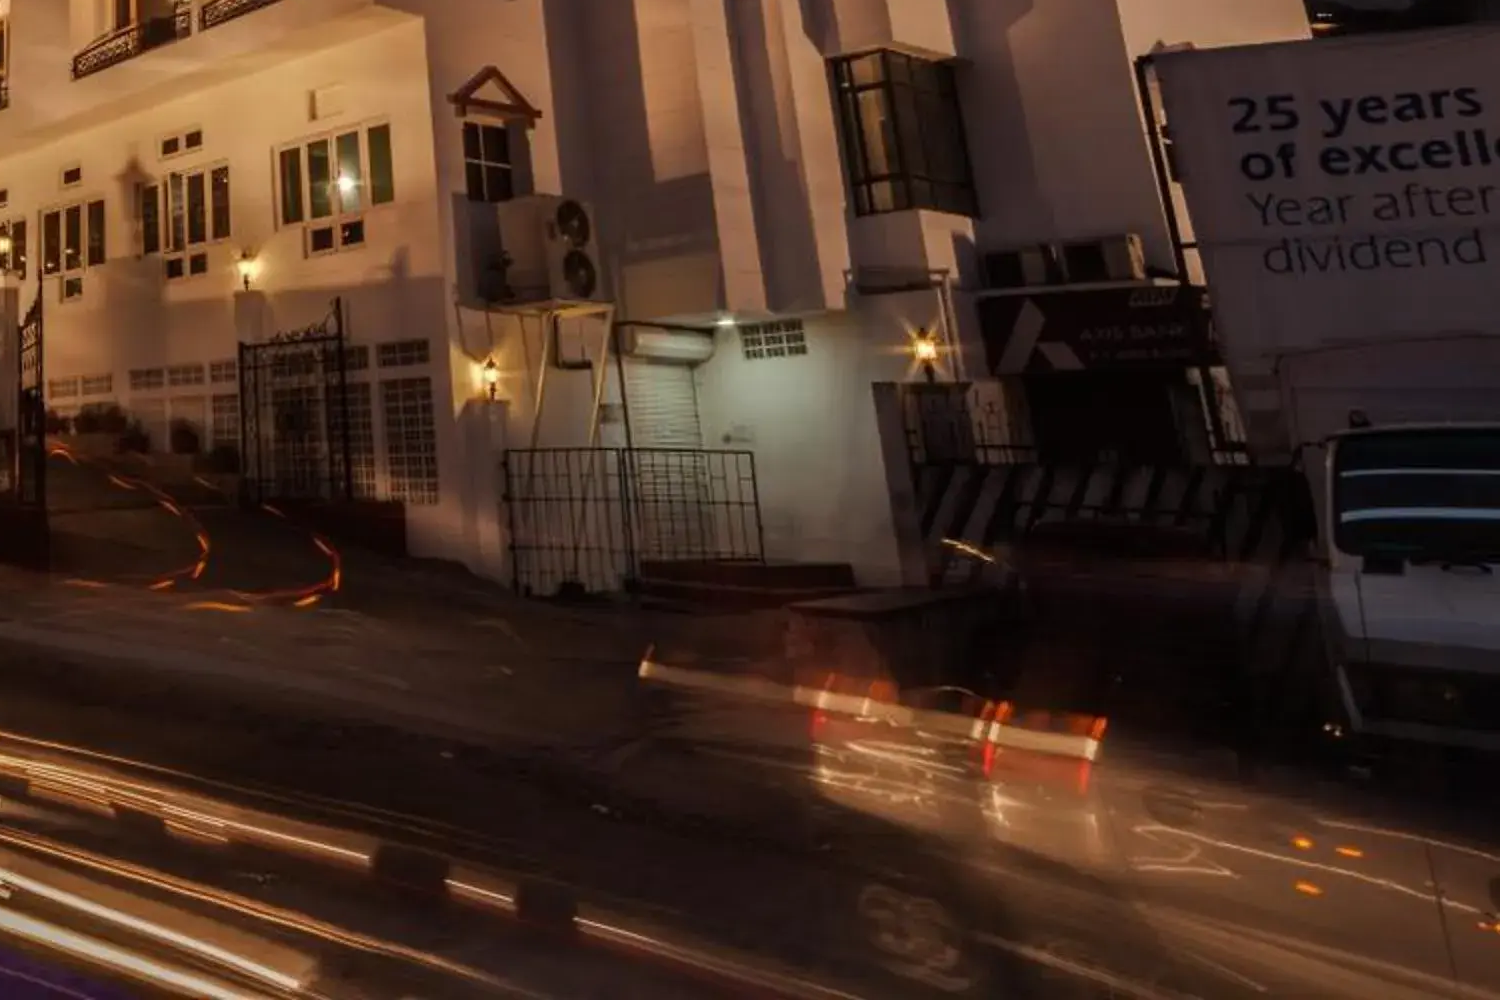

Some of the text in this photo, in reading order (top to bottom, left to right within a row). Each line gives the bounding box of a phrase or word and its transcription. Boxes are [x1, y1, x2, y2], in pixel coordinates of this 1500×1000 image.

[1227, 87, 1483, 138] 25 years
[1240, 128, 1500, 181] of excell
[1246, 181, 1499, 227] Year after
[1263, 228, 1487, 274] dividend
